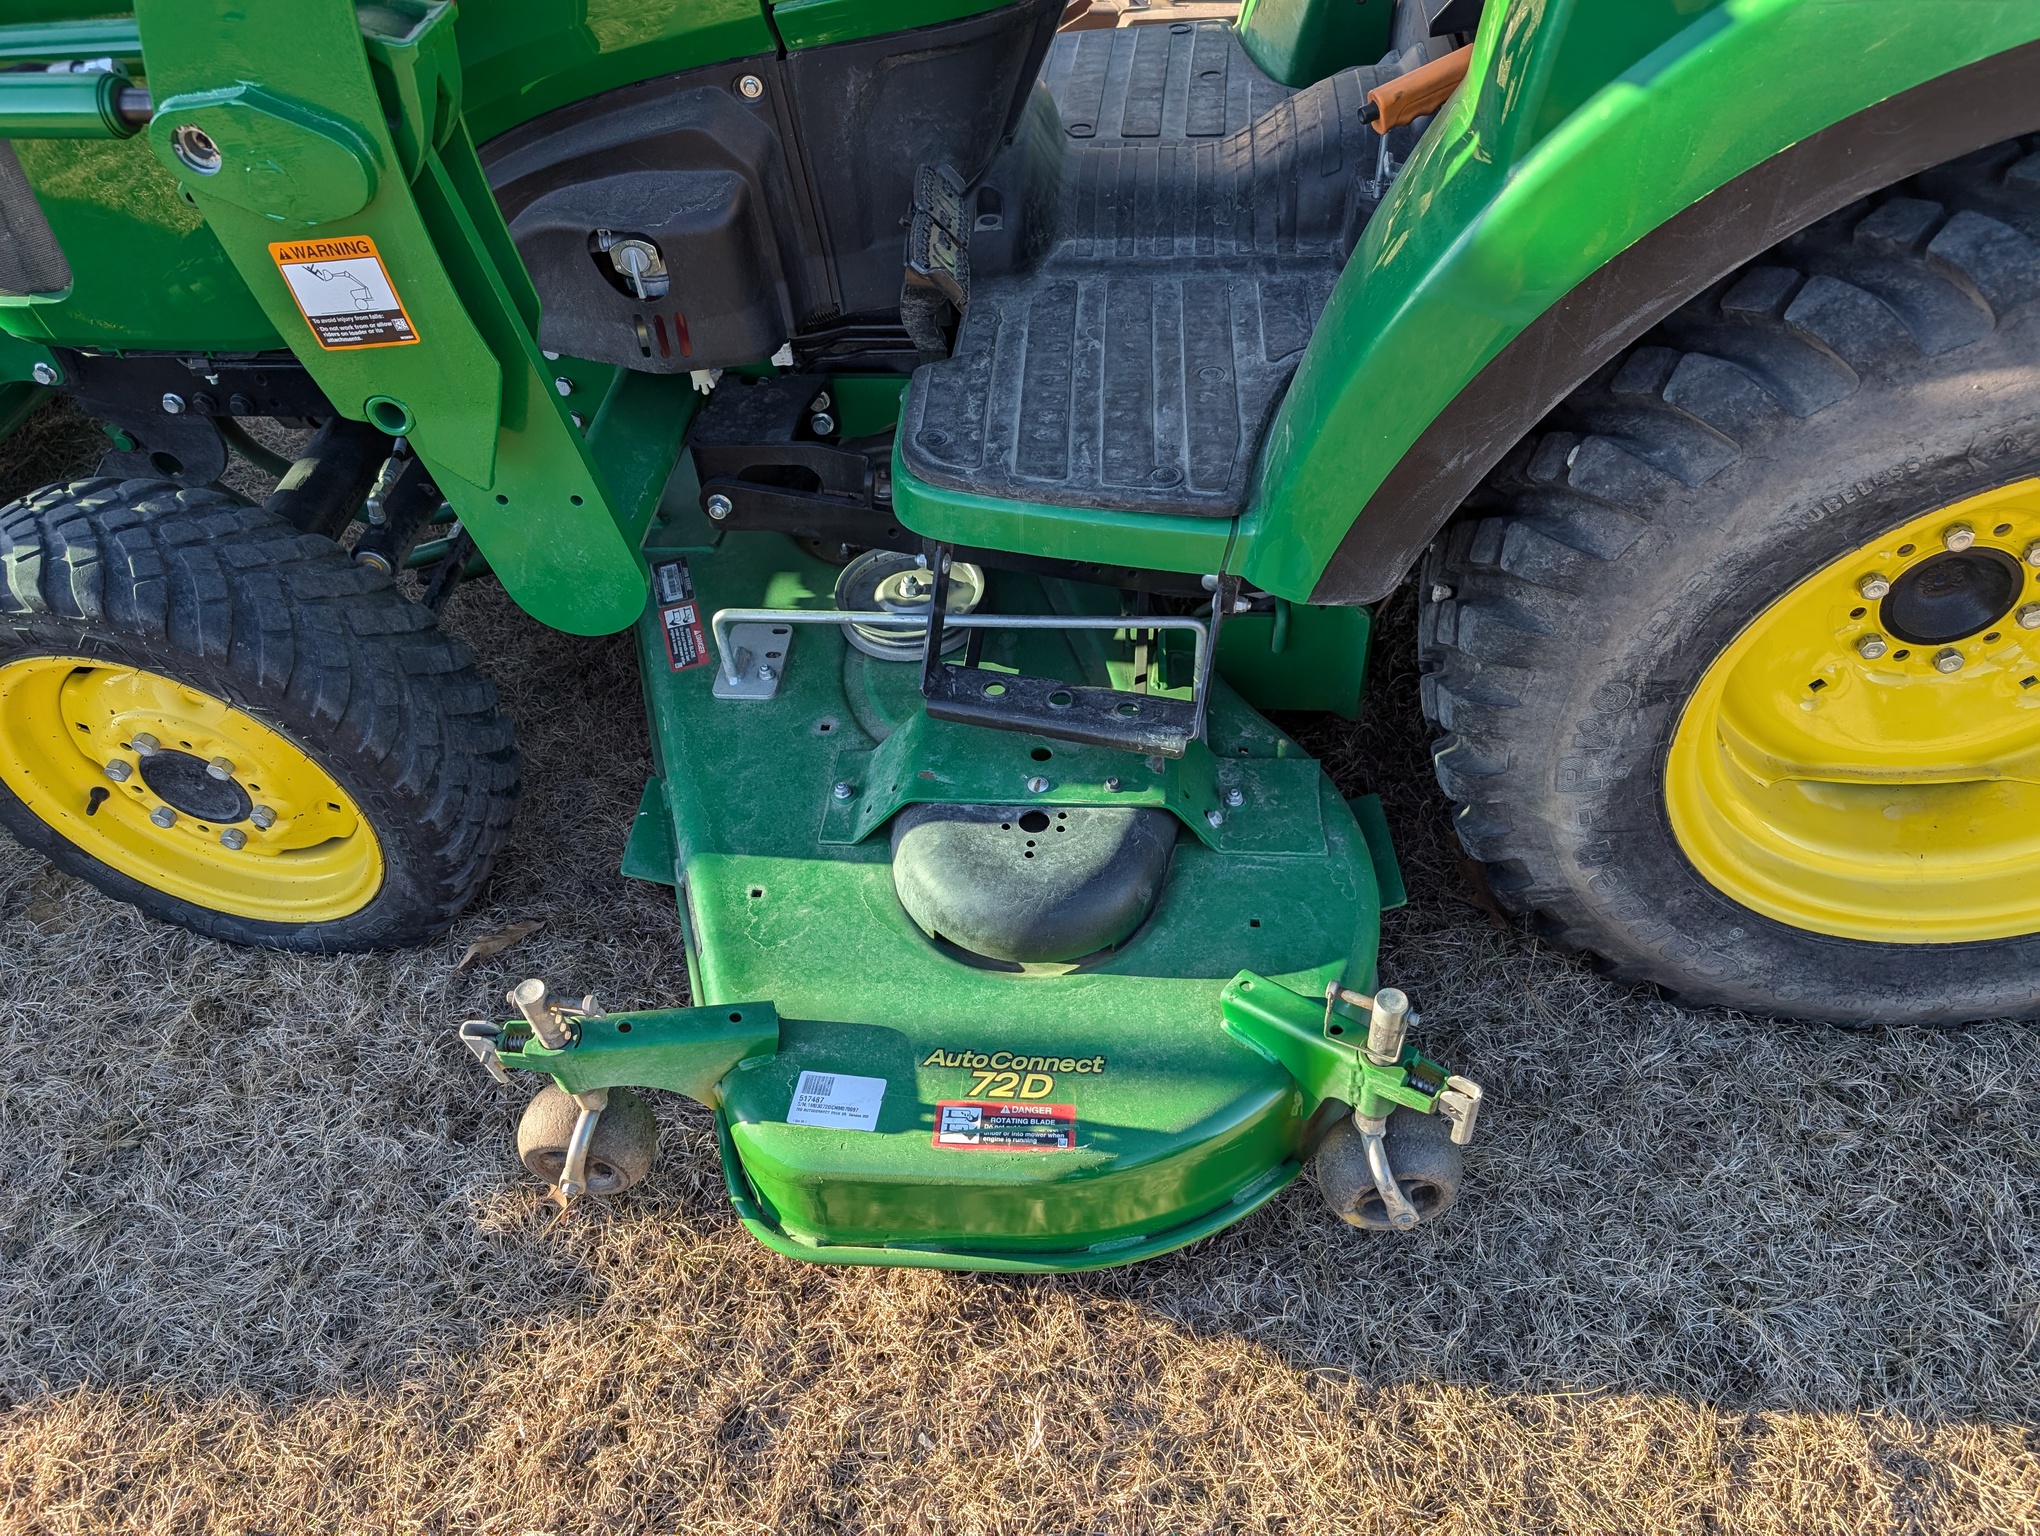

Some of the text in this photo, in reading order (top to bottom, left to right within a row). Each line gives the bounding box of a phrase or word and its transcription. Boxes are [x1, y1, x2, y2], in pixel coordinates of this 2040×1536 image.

[289, 240, 370, 260] WARNING
[1796, 455, 1921, 531] TUBELESS
[694, 633, 705, 654] DANGER
[921, 1047, 1105, 1074] AutoConnect
[966, 1070, 1054, 1099] 72D
[1012, 1106, 1052, 1114] DANGER
